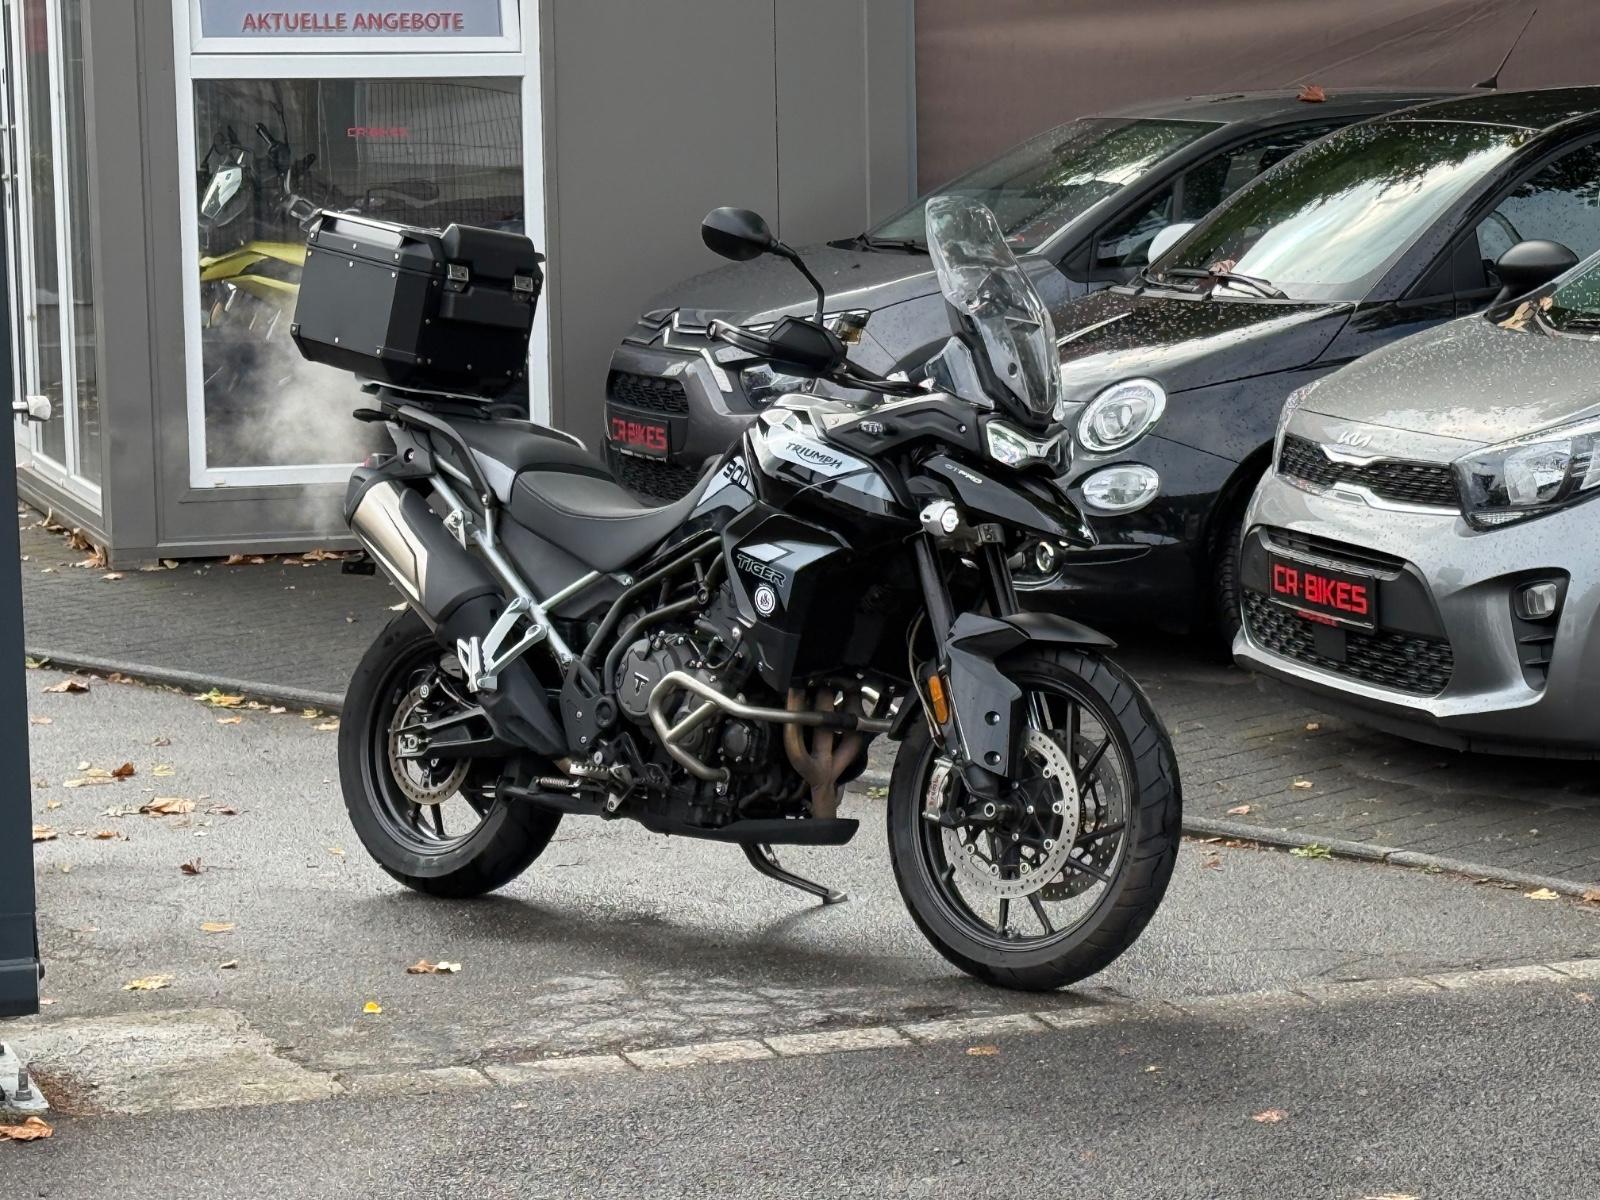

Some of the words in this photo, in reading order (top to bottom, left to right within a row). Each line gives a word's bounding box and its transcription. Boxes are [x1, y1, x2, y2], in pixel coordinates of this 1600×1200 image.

[242, 12, 348, 32] AKTUELLE
[352, 12, 465, 32] ANGEBOTE
[785, 441, 843, 470] TRIUMPH
[736, 553, 787, 588] TIGER
